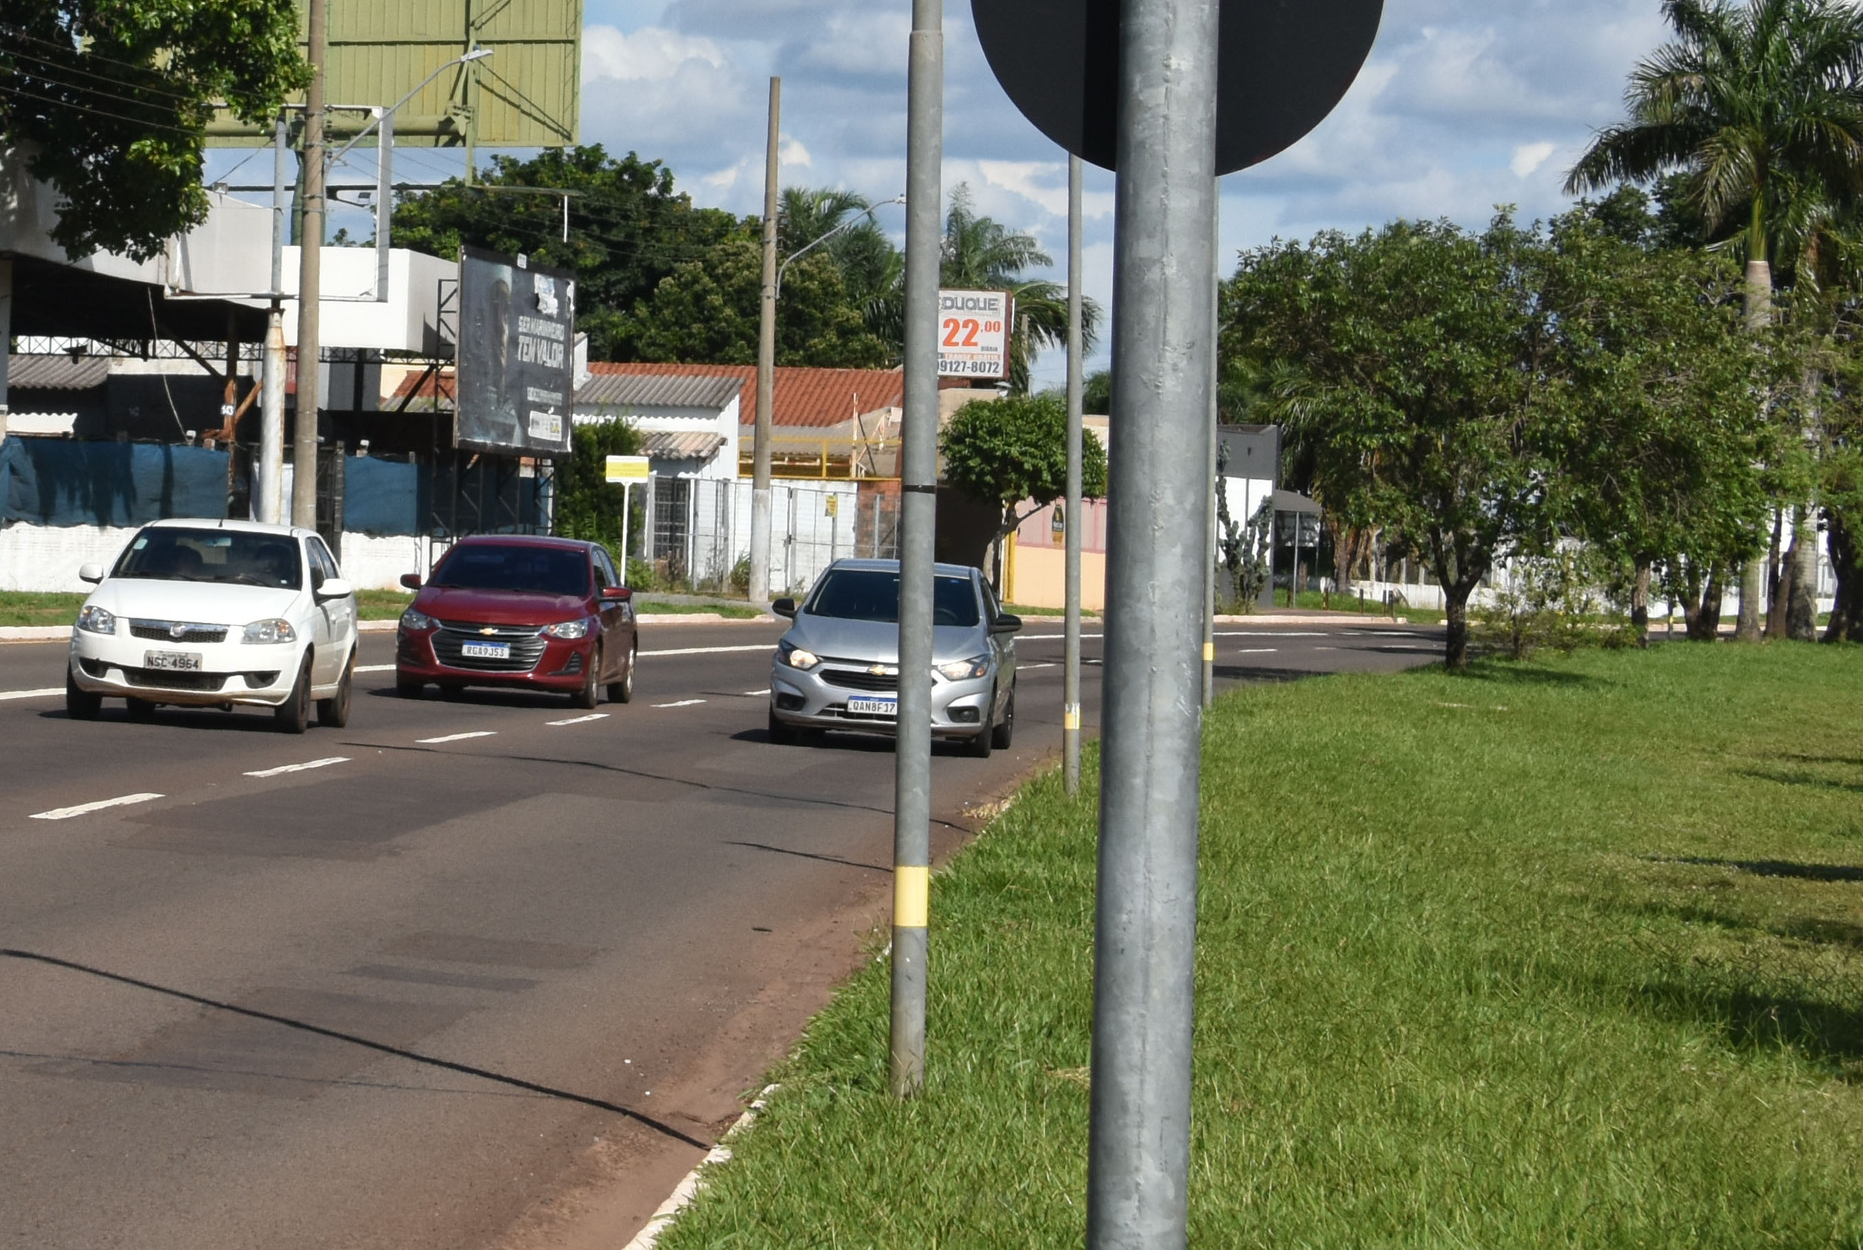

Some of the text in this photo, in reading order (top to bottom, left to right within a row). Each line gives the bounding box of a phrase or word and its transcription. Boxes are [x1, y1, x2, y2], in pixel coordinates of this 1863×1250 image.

[943, 296, 998, 311] DUQUE
[518, 335, 564, 370] TEM VALOR
